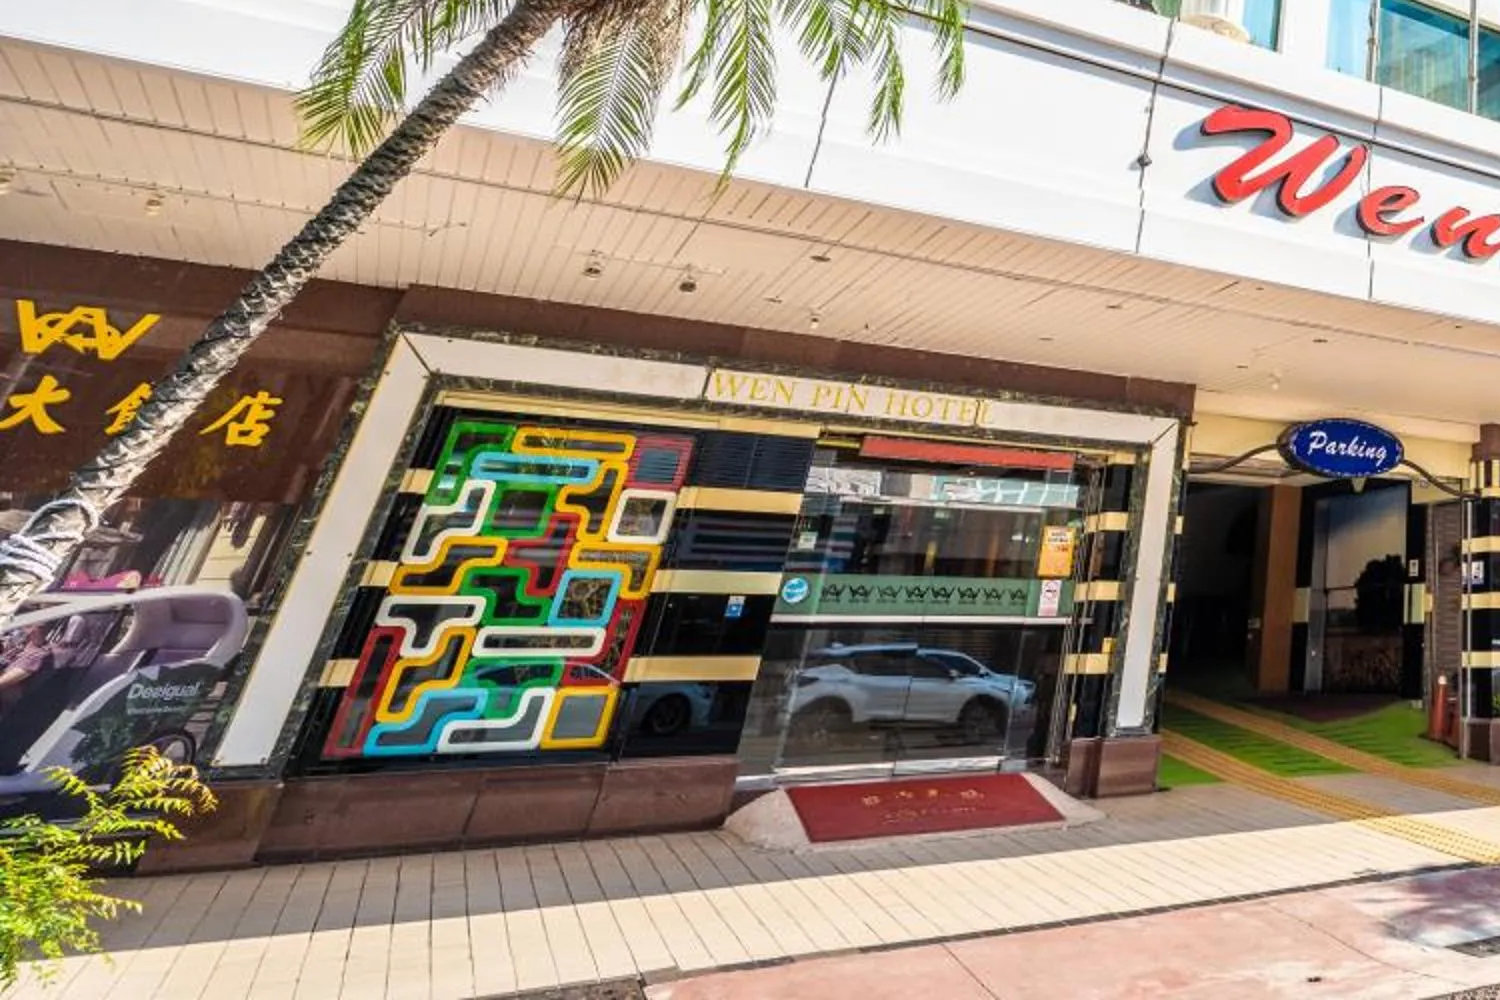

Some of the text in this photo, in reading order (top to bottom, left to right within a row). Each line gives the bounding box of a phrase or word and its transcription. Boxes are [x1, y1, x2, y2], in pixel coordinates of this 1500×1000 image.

[711, 373, 995, 425] WEN PIN HOTEL
[1307, 430, 1388, 467] Parking
[127, 681, 204, 701] Desigual
